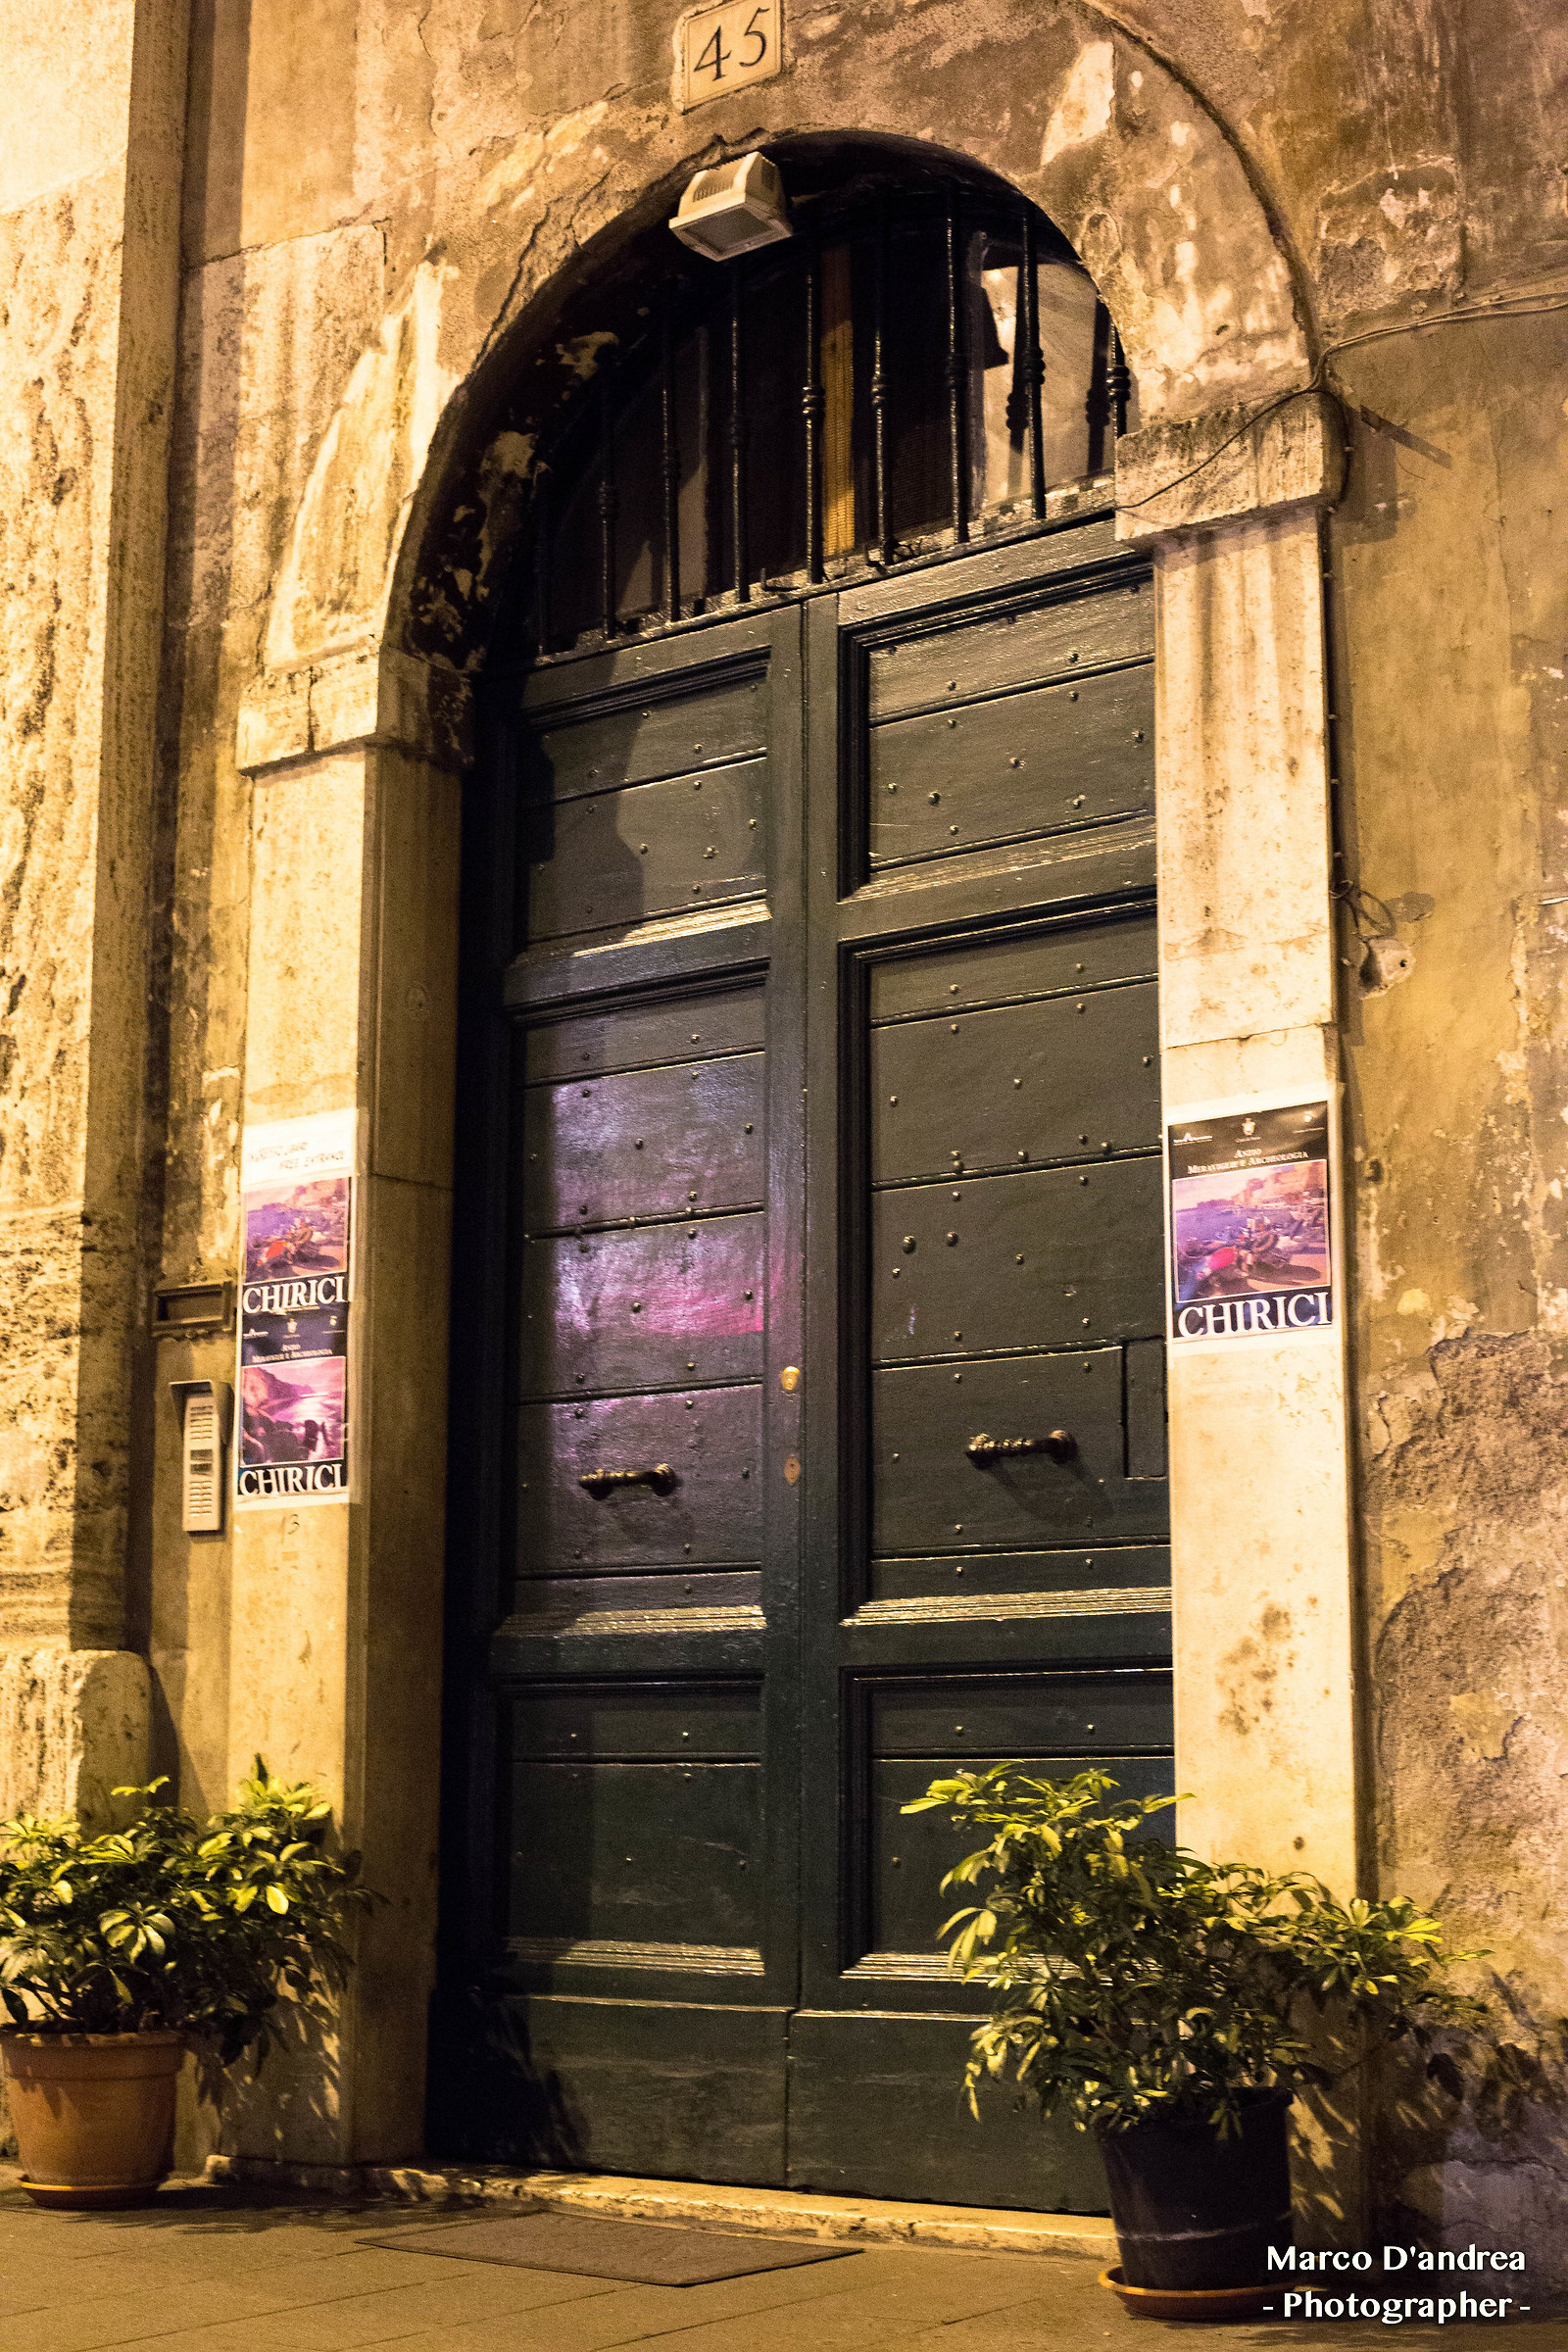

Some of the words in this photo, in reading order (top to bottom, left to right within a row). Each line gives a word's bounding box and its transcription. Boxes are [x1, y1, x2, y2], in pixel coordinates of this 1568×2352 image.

[694, 8, 769, 81] 45
[242, 1276, 348, 1314] CHIRICI
[1177, 1292, 1332, 1339] CHIRICI
[239, 1463, 344, 1497] CHIRICI
